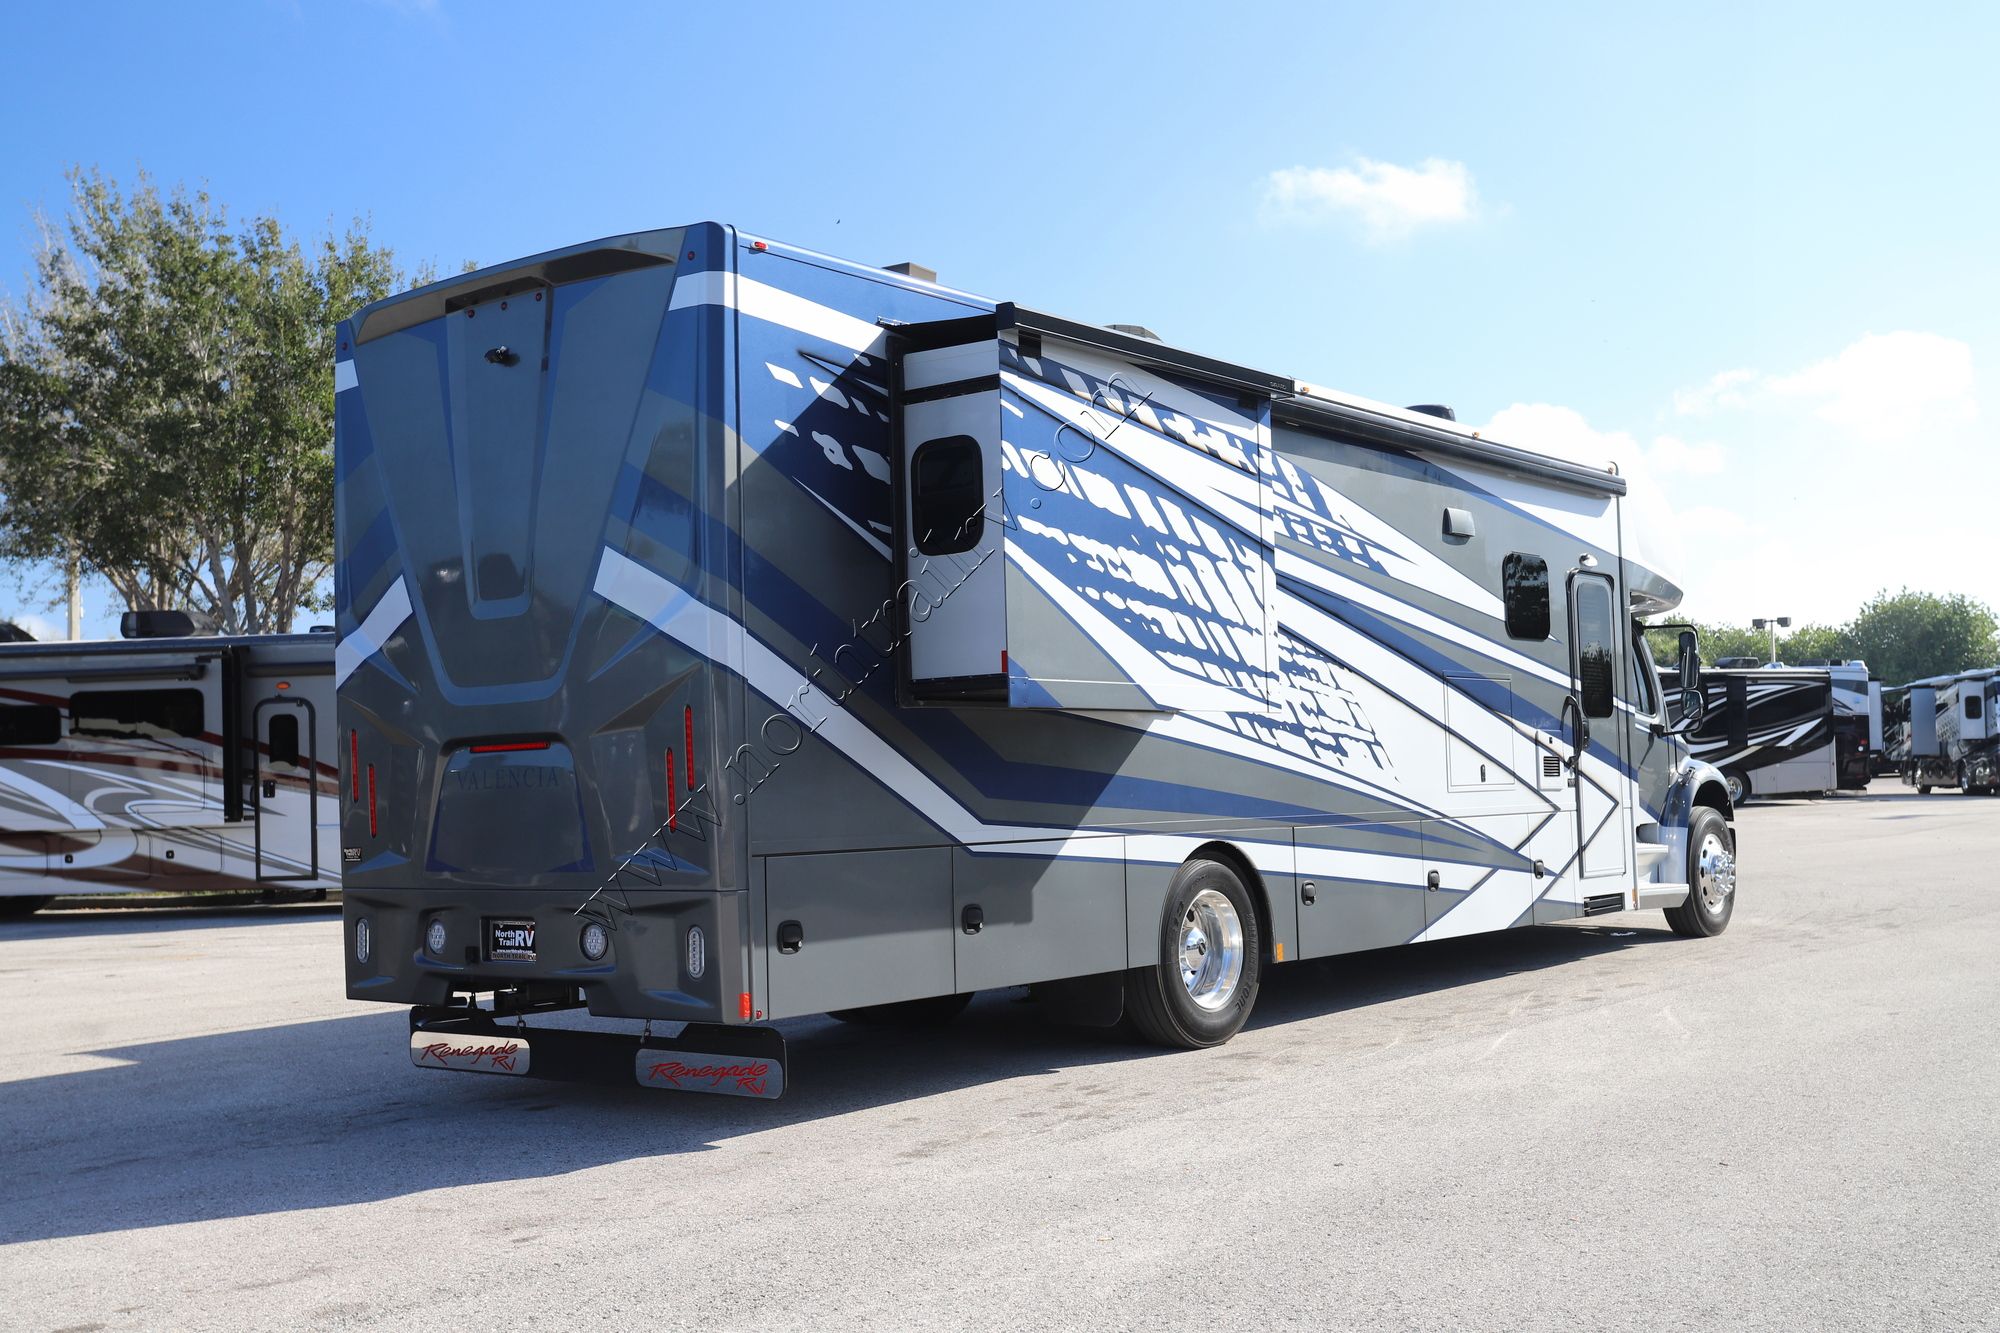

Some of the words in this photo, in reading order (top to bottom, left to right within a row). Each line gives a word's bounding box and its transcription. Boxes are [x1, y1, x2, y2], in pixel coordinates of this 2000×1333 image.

[458, 767, 559, 790] VALENCIA
[495, 930, 515, 938] North
[499, 938, 515, 946] Trail
[515, 930, 535, 947] RV
[421, 1041, 518, 1066] Renegade
[491, 1055, 516, 1072] RV
[648, 1061, 768, 1087] Renegade
[736, 1077, 766, 1094] RV
